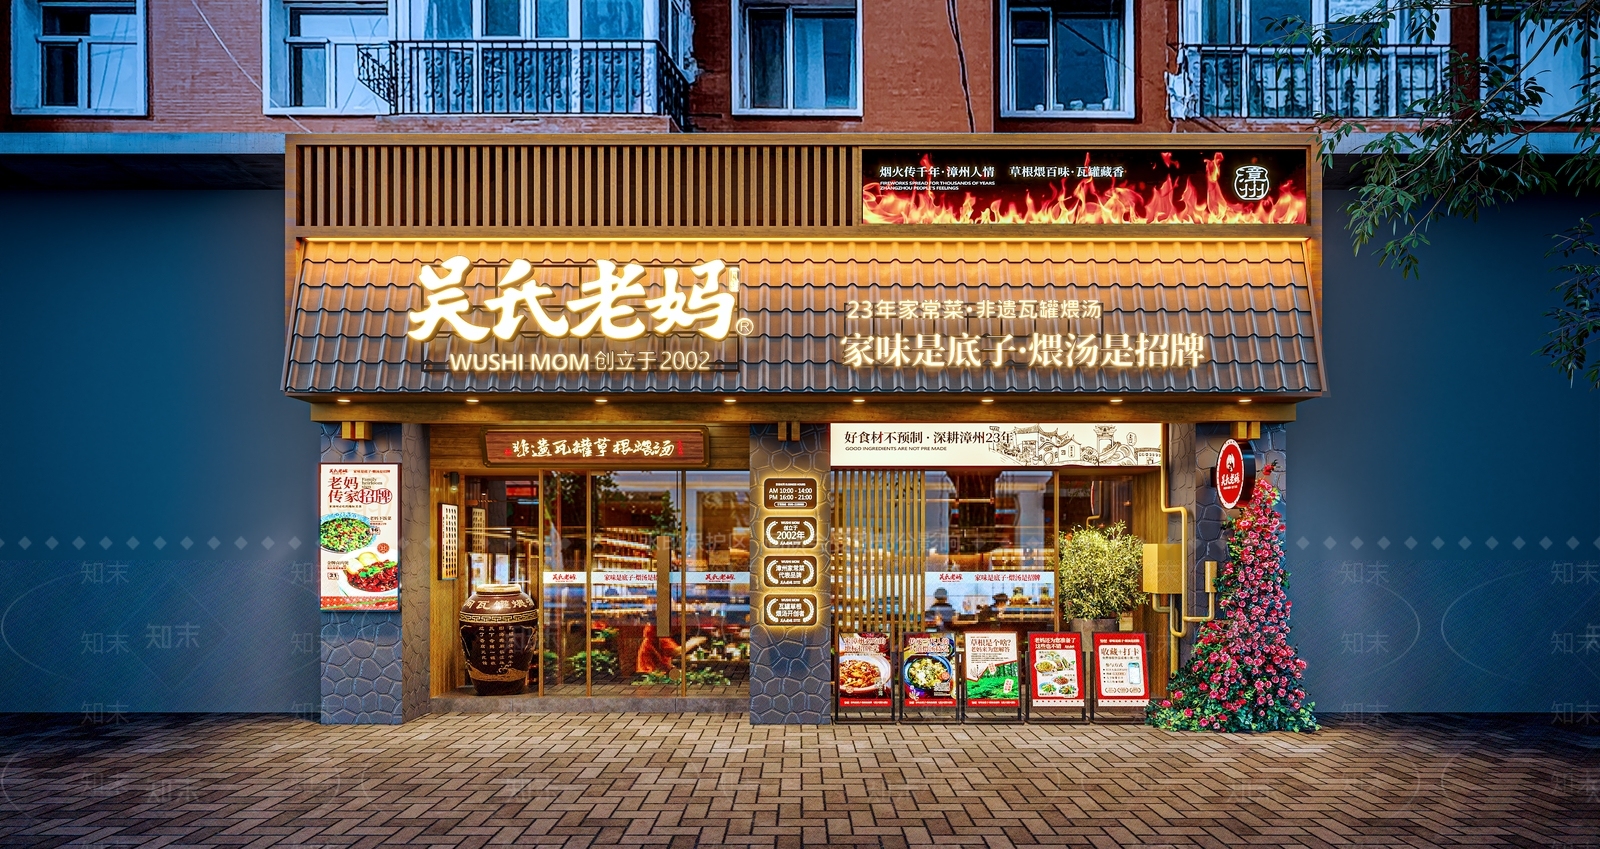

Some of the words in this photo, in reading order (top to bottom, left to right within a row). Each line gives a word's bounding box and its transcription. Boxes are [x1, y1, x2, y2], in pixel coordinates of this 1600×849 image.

[879, 166, 995, 178] 烟火传千年·漳州人情
[1009, 166, 1124, 178] 草根煨百味·瓦罐藏香
[407, 255, 736, 343] 吴氏老妈
[847, 299, 1102, 320] 23年家常菜·非遗瓦罐煨汤
[840, 332, 1205, 368] 家味是底子·煨汤是招牌
[450, 354, 527, 372] WUSHI
[530, 354, 589, 372] MOM
[594, 351, 657, 371] 创立于
[660, 351, 710, 371] 2002
[328, 477, 358, 489] 老妈
[328, 490, 391, 503] 传家招牌
[777, 531, 805, 540] 2002年
